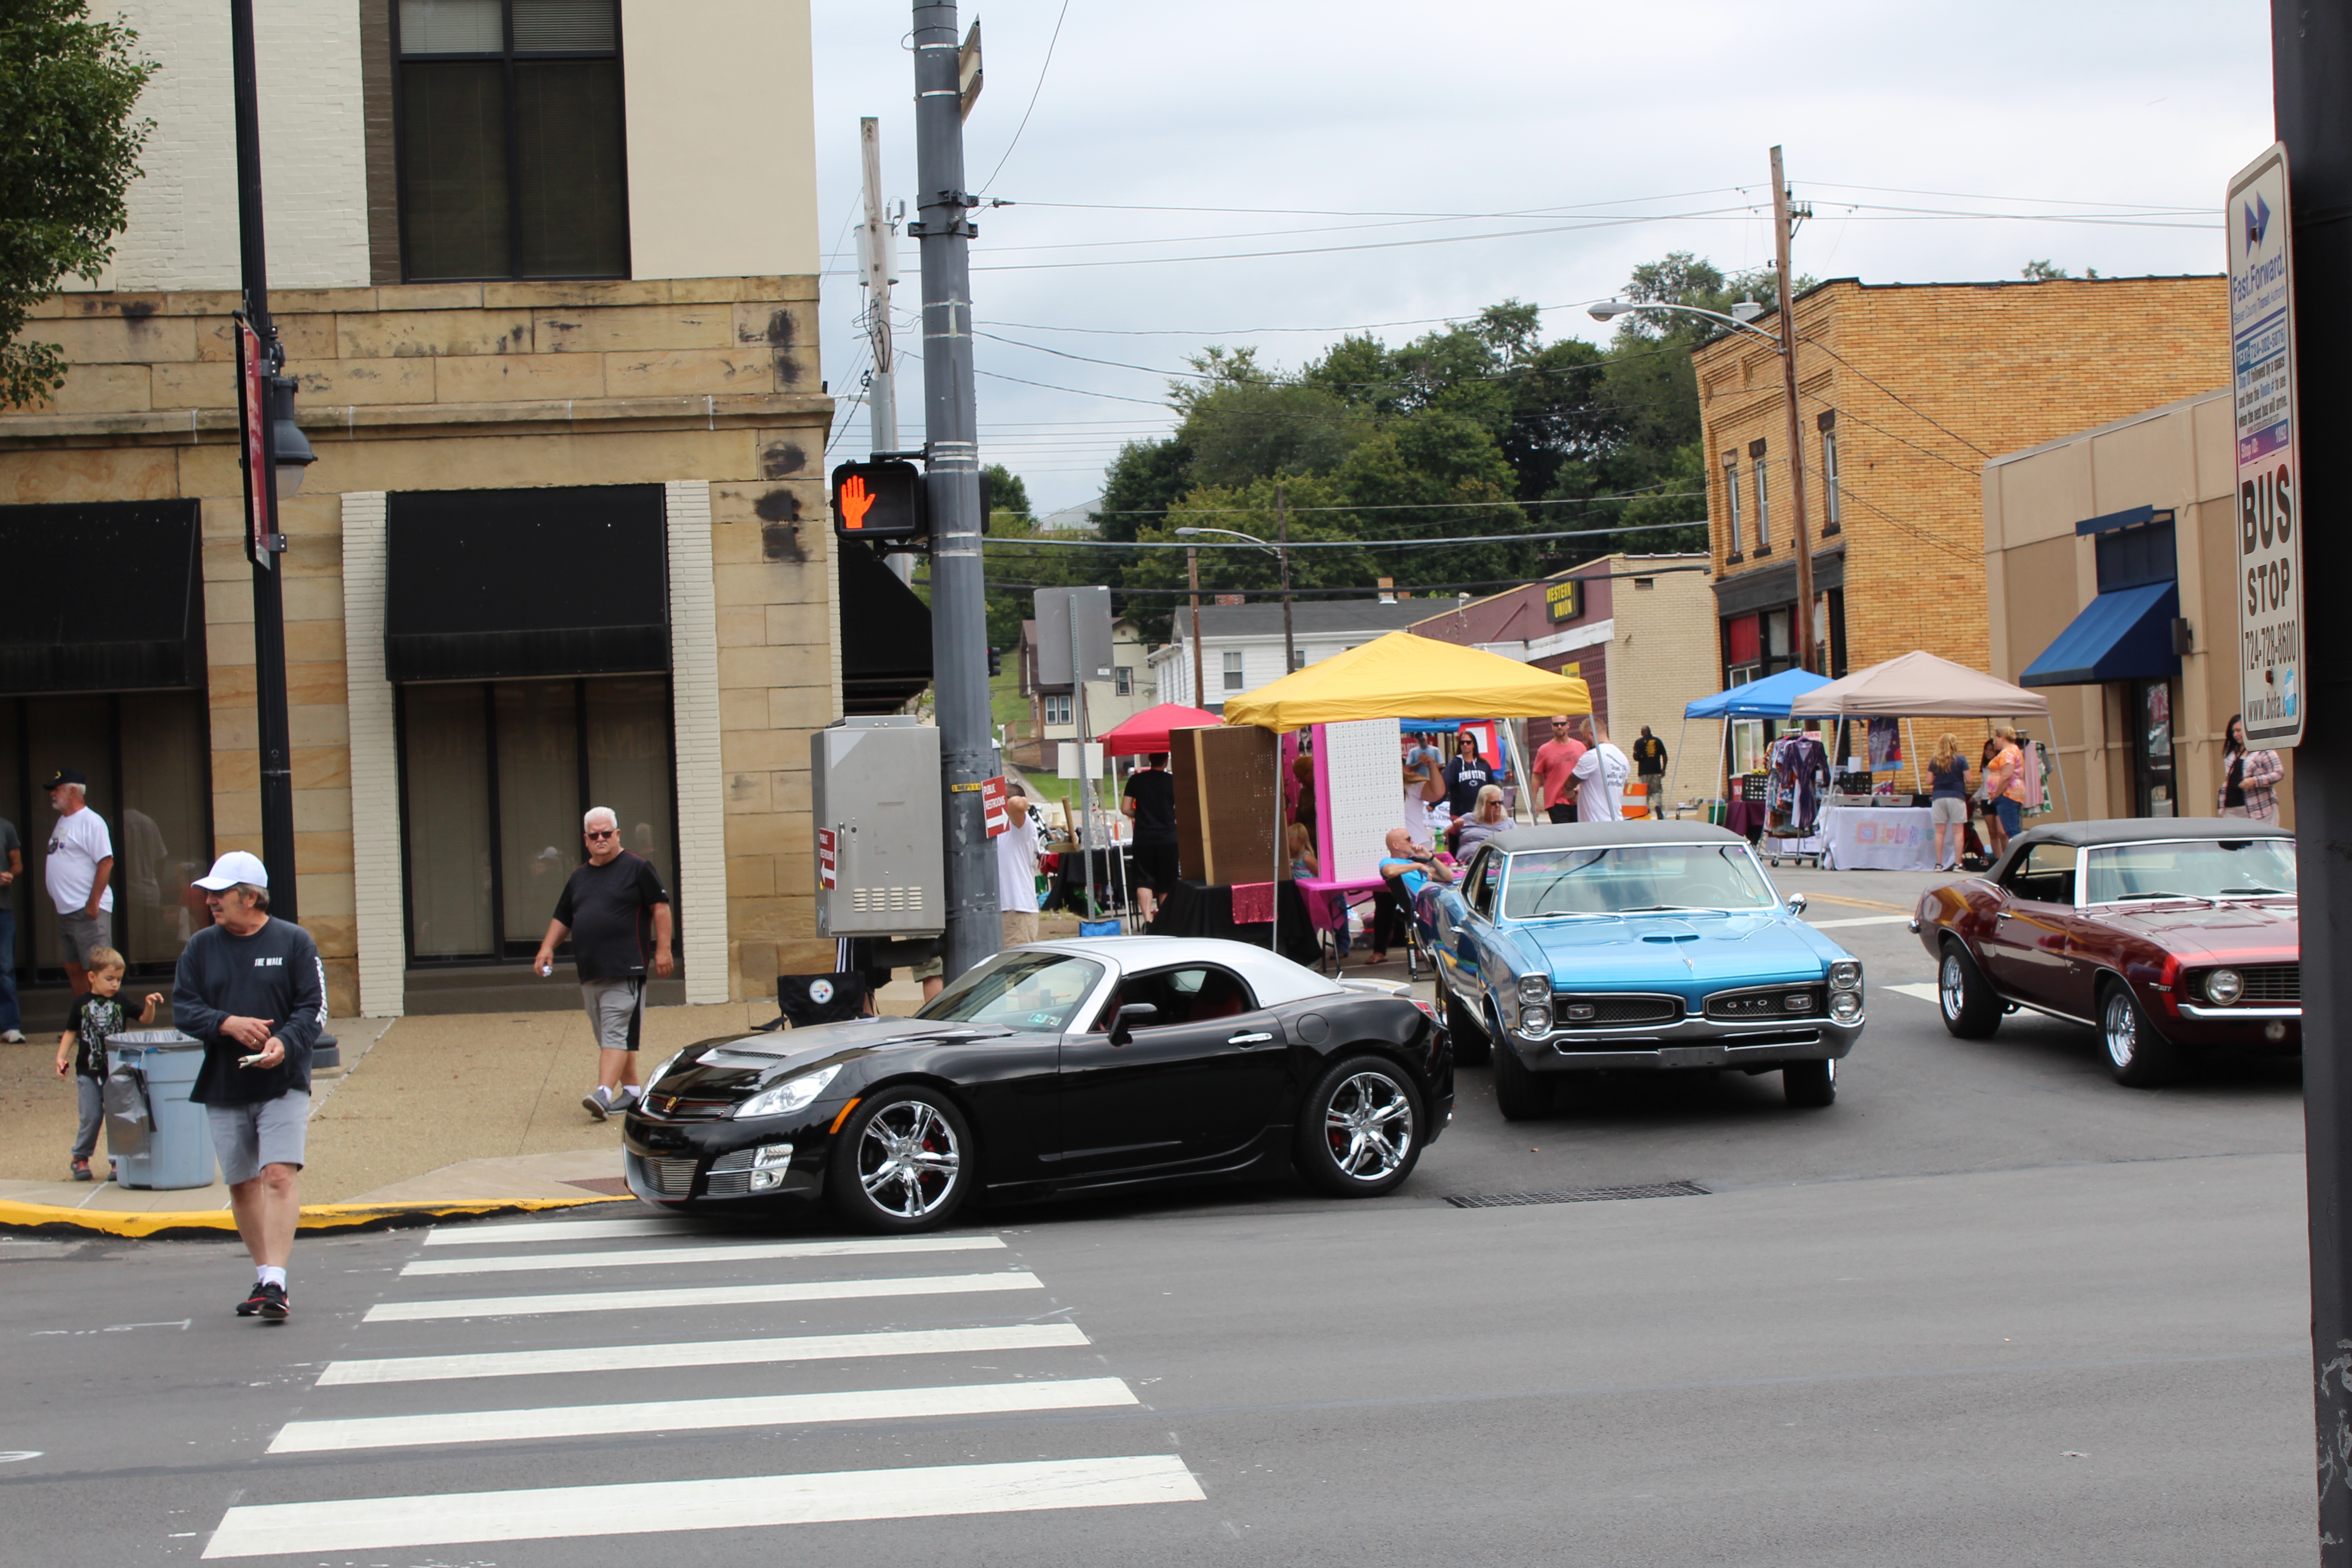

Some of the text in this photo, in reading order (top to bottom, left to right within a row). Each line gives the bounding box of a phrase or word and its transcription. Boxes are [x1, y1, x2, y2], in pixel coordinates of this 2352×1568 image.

[2274, 355, 2284, 373] space
[2241, 442, 2251, 460] Stop
[2241, 464, 2291, 555] BUS
[2247, 558, 2289, 617] STOP
[2245, 619, 2296, 671] 724-728-8600
[1459, 769, 1486, 783] PENN STATE
[983, 783, 996, 795] PUBLIC
[985, 795, 1006, 811] RESTROOMS
[819, 833, 828, 845] PUBLIC
[819, 848, 834, 862] RESTROOMS
[254, 957, 283, 967] THE WALK
[1727, 999, 1768, 1008] GTO
